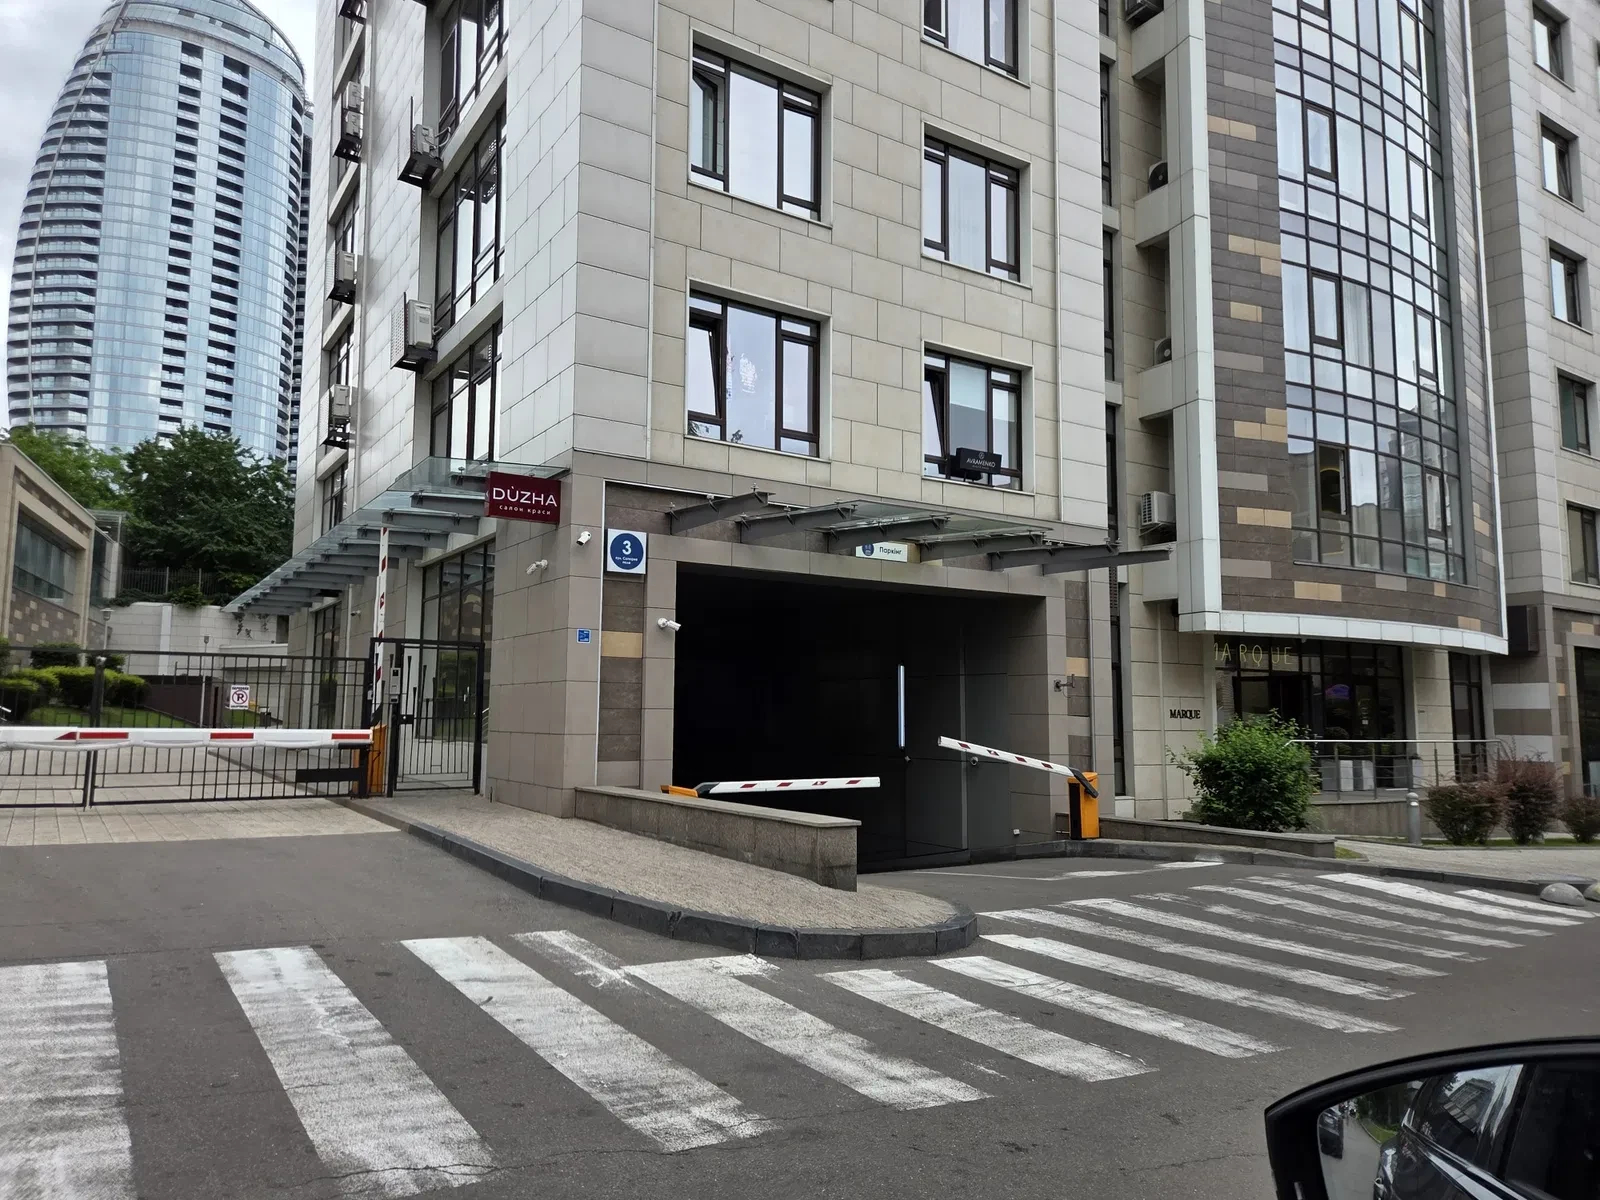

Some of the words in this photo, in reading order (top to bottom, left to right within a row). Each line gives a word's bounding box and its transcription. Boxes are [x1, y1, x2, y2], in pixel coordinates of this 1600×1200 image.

[966, 458, 996, 468] AVRAMENKO
[622, 540, 632, 555] 3
[879, 546, 902, 555] Паркінг
[1169, 709, 1201, 720] MARQUE
